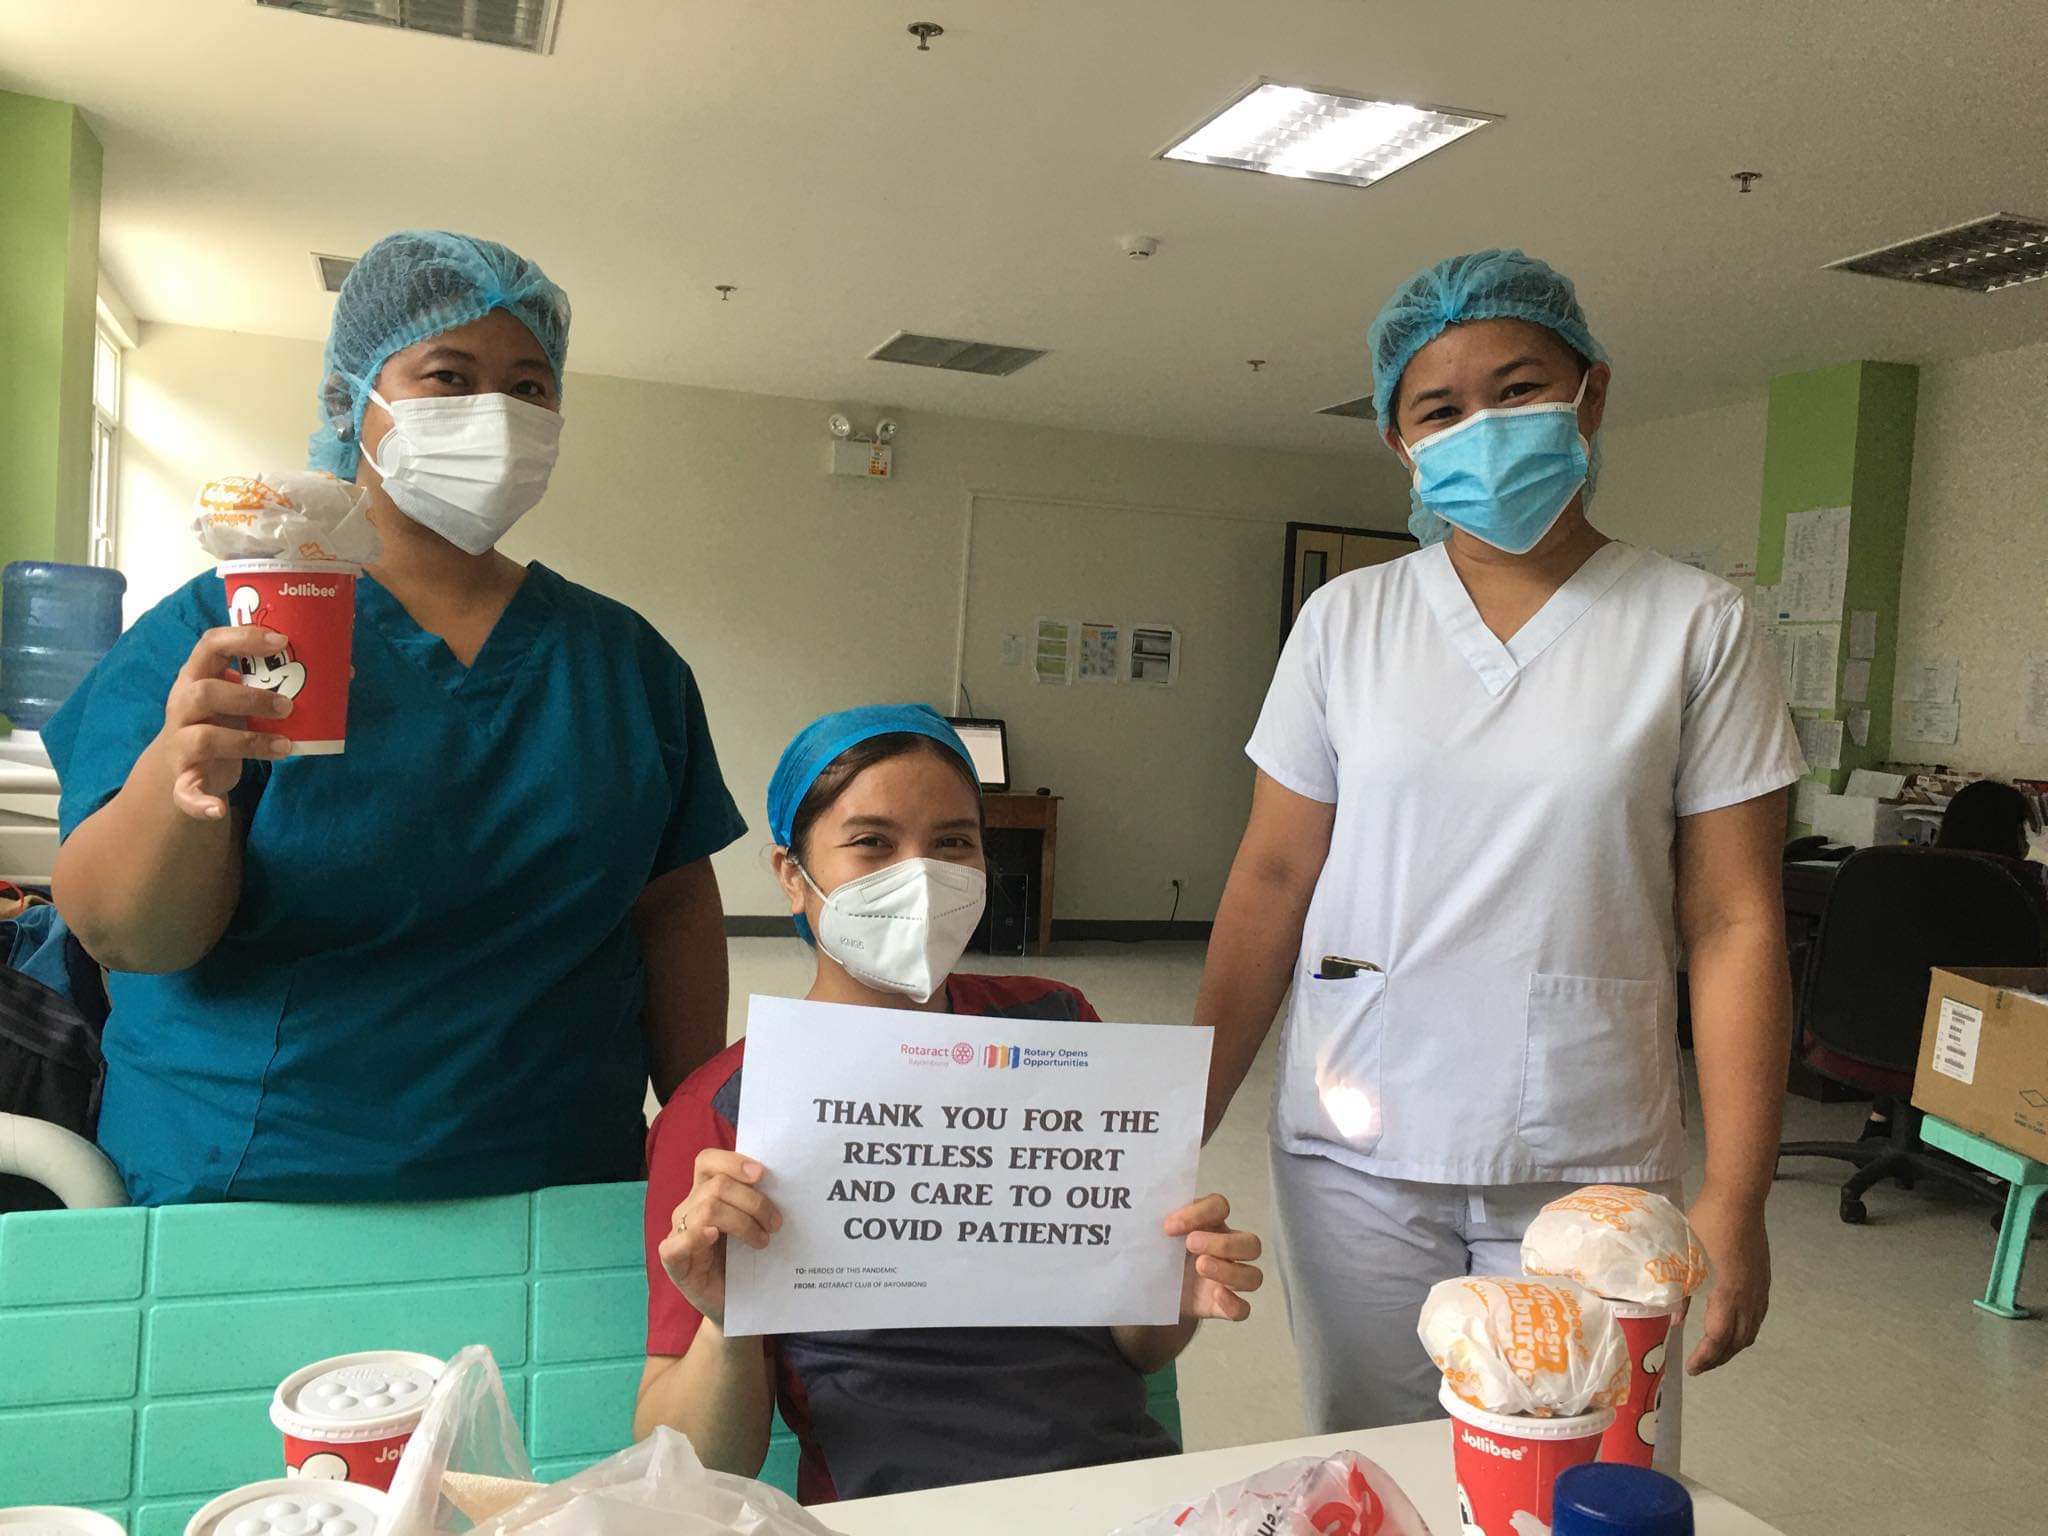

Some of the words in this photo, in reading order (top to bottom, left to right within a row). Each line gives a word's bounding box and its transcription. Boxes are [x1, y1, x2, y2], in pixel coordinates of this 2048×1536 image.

[278, 582, 336, 597] Jollibee
[900, 1043, 949, 1057] Rotaract
[1024, 1048, 1055, 1057] Rotary
[1058, 1049, 1088, 1058] Opens
[1023, 1058, 1088, 1068] Opportunities
[813, 1099, 922, 1128] THANK
[942, 1106, 1008, 1130] YOU
[1023, 1108, 1084, 1132] FOR
[1101, 1110, 1159, 1134] THE
[843, 1141, 993, 1169] RESTLESS
[1008, 1146, 1125, 1172] EFFORT
[827, 1179, 896, 1203] AND
[910, 1182, 993, 1206] CARE
[1010, 1184, 1052, 1208] TO
[1066, 1186, 1132, 1209] OUR
[843, 1217, 943, 1241] COVID
[957, 1221, 1111, 1246] PATIENTS!
[809, 1267, 834, 1275] HEROES
[883, 1280, 928, 1288] BAYOMBONG
[1461, 1429, 1523, 1461] Jollibee
